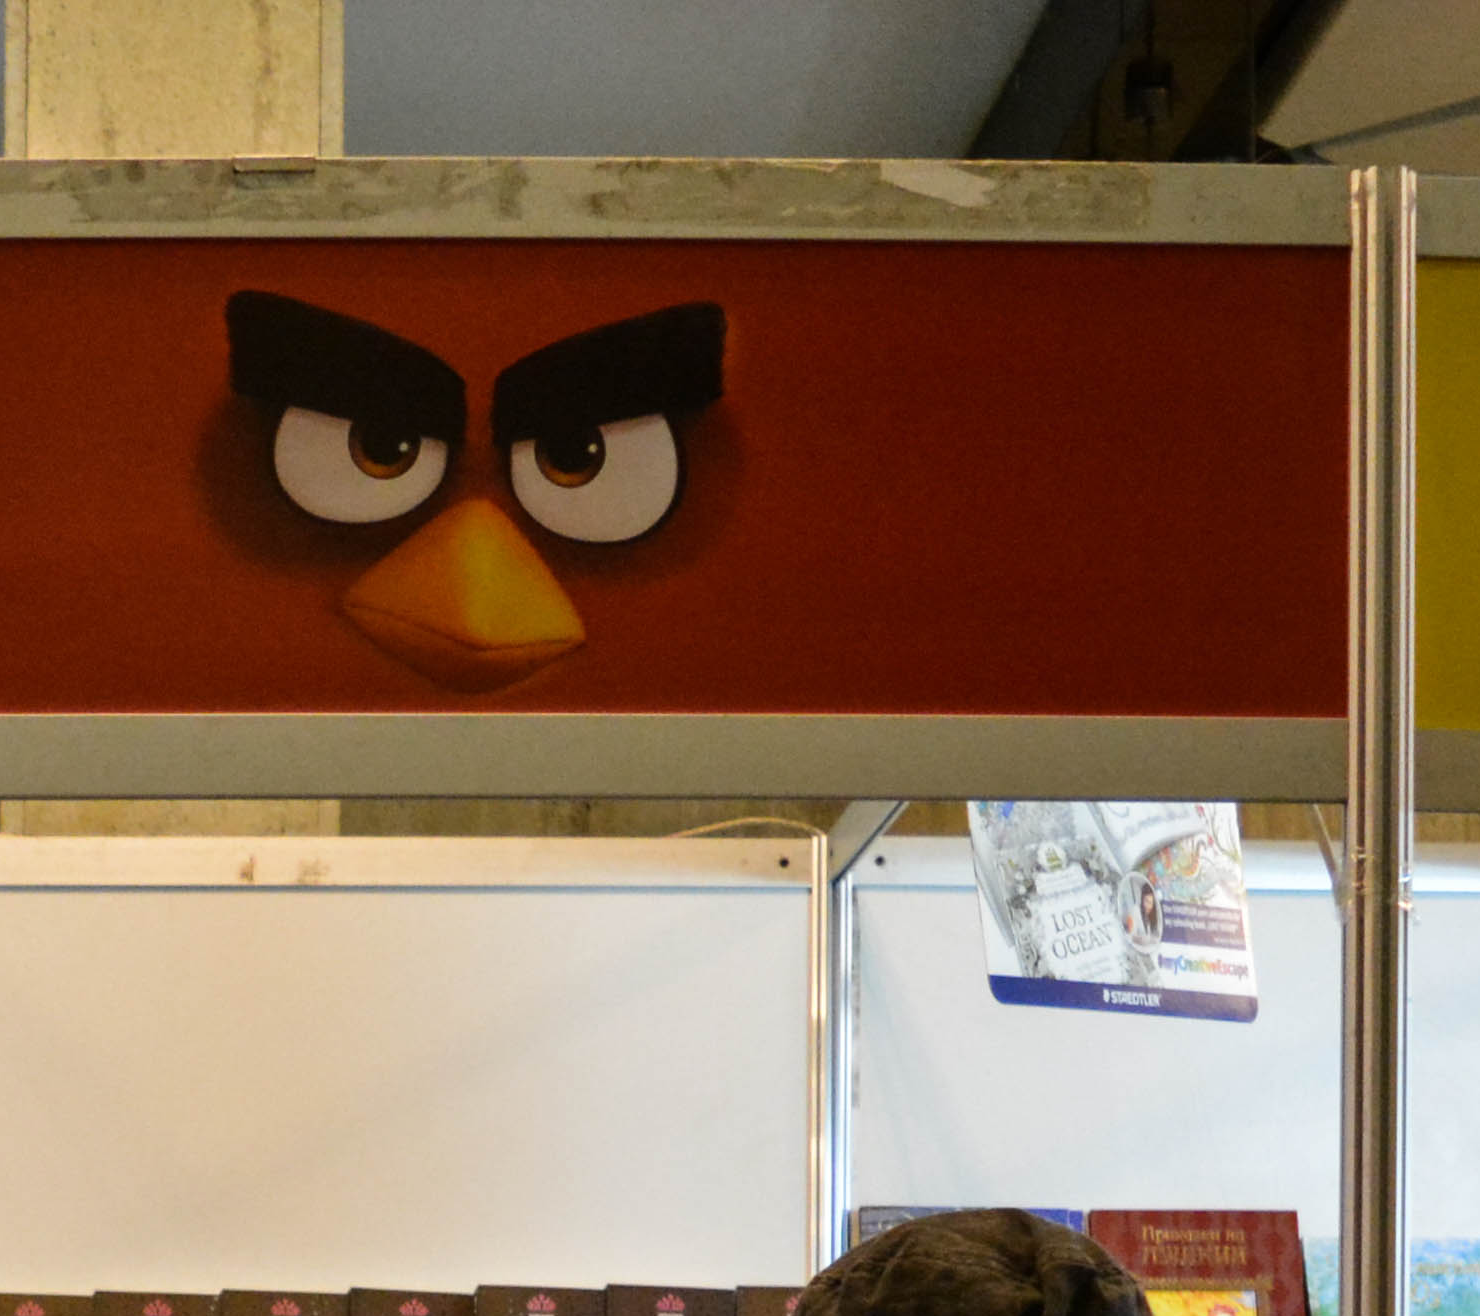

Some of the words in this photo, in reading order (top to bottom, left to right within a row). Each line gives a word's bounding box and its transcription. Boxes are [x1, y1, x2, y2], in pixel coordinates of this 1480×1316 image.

[1050, 904, 1095, 934] LOST
[1050, 922, 1115, 960] OCEAN
[1110, 991, 1161, 1007] STAEDTLER
